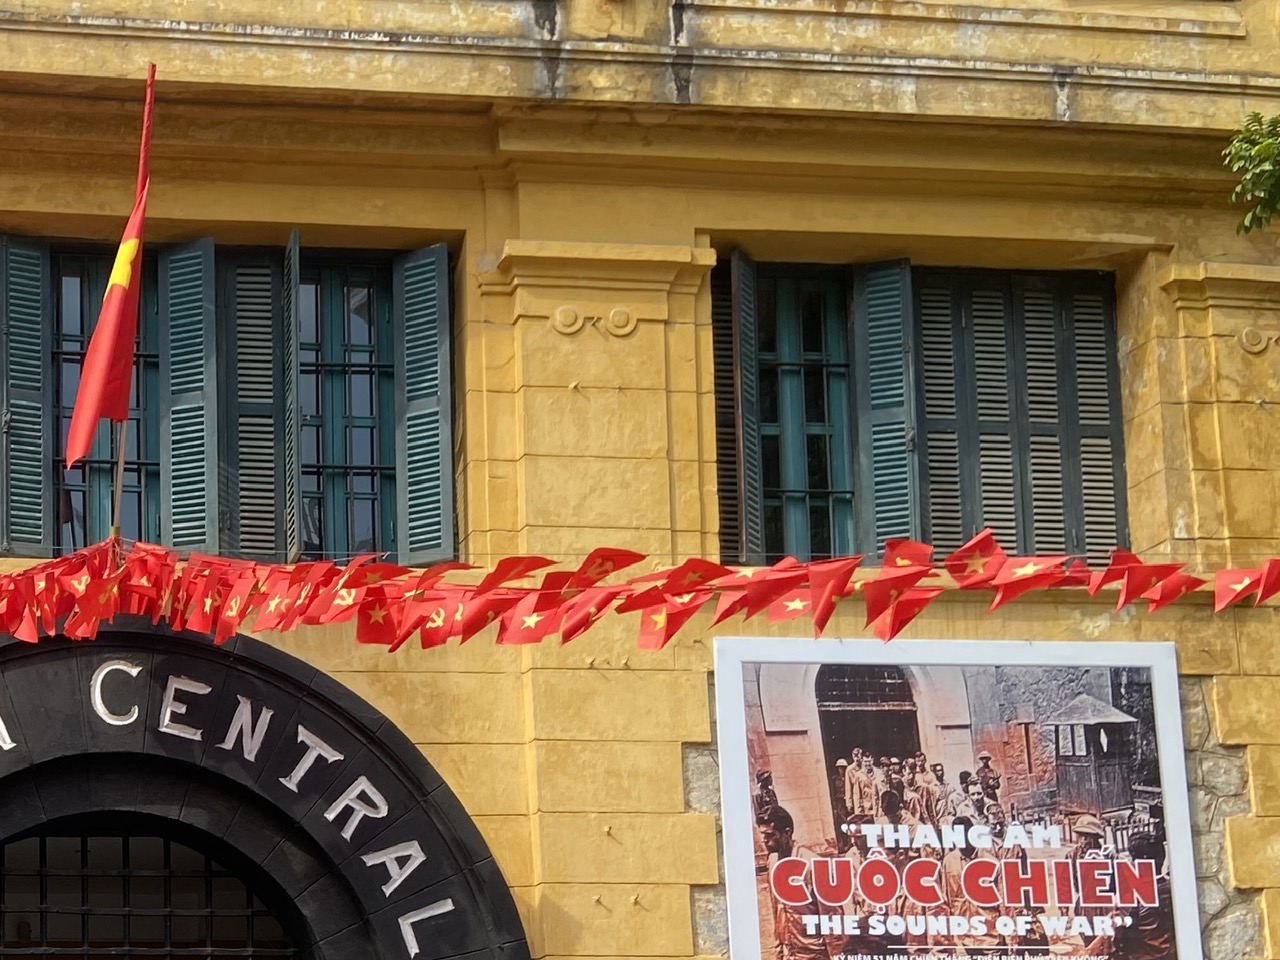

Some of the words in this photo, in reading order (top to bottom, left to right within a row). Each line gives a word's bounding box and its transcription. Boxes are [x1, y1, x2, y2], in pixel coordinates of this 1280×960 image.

[1003, 821, 1062, 849] ÂM
[770, 848, 944, 914] CUỘC
[961, 845, 1159, 907] CHIẾN
[802, 915, 860, 936] THE
[868, 915, 988, 936] SOUNDS
[995, 916, 1032, 936] OF
